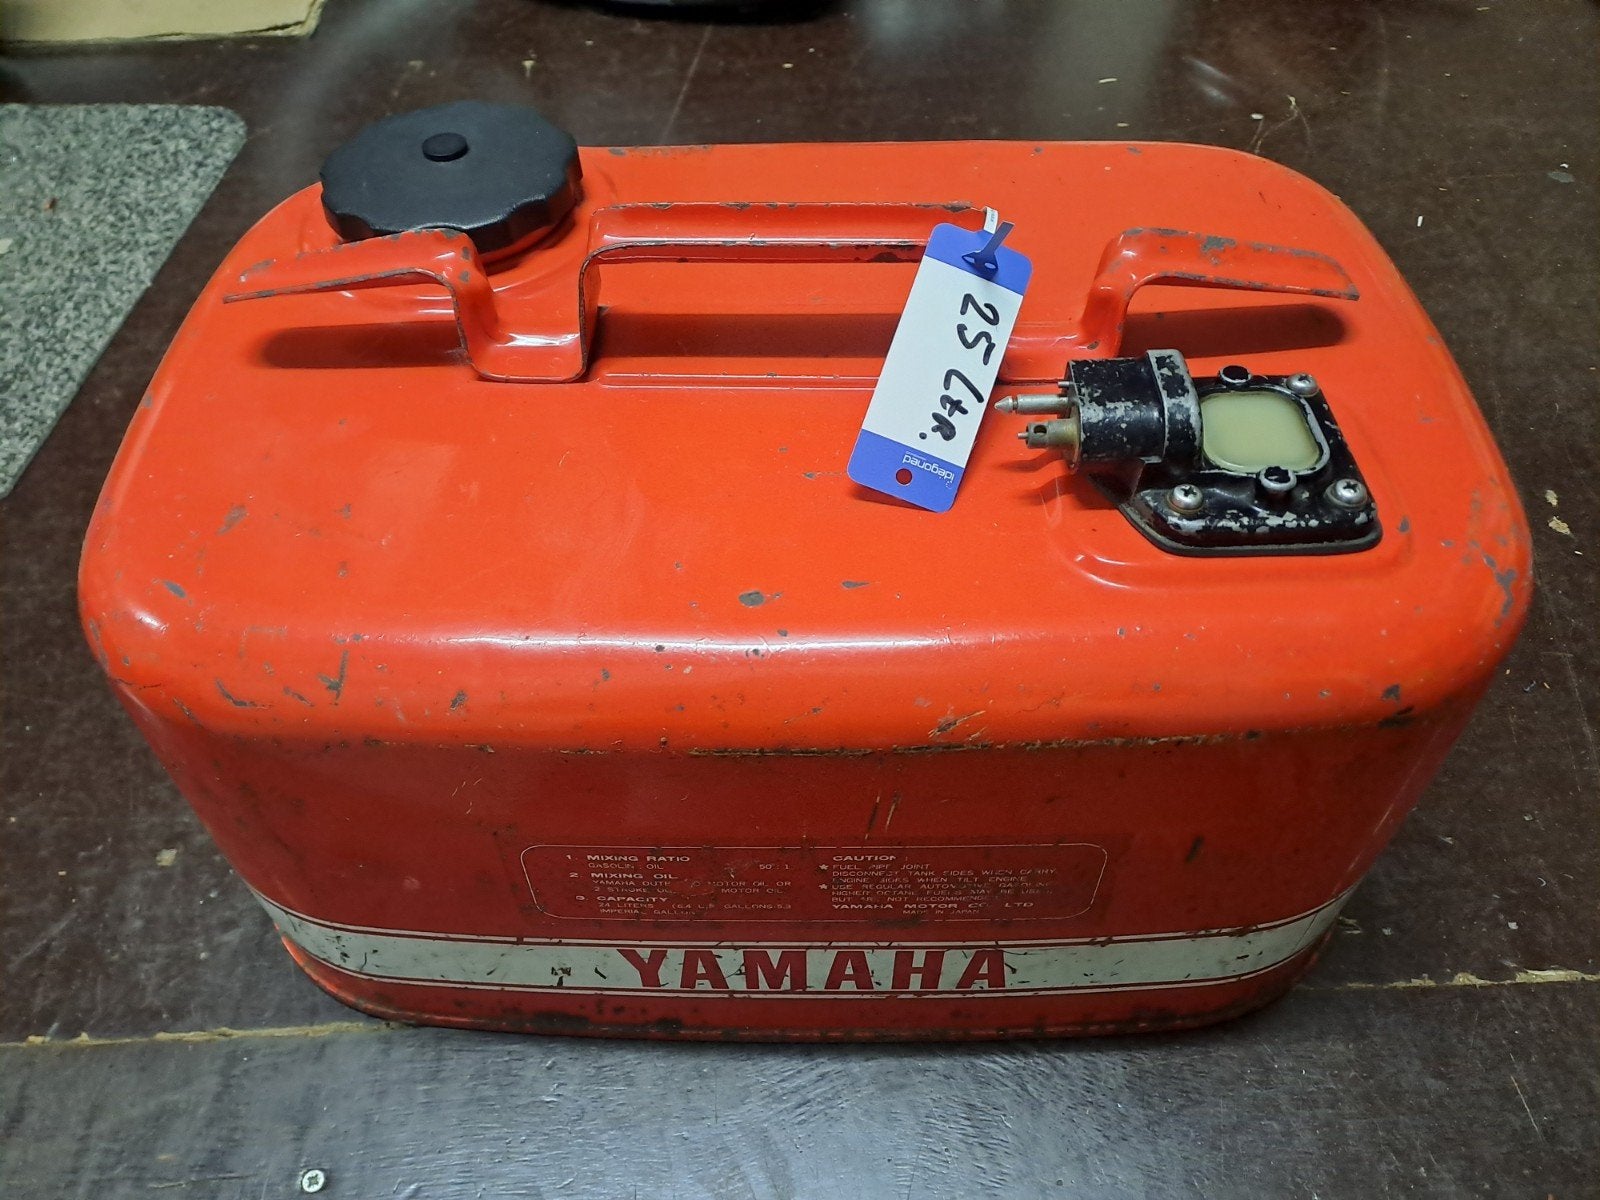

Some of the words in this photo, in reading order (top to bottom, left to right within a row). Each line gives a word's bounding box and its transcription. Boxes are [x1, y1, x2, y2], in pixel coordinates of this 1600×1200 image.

[957, 292, 1001, 366] 25
[587, 854, 639, 862] MIXING
[617, 948, 1007, 992] YAMAHA
